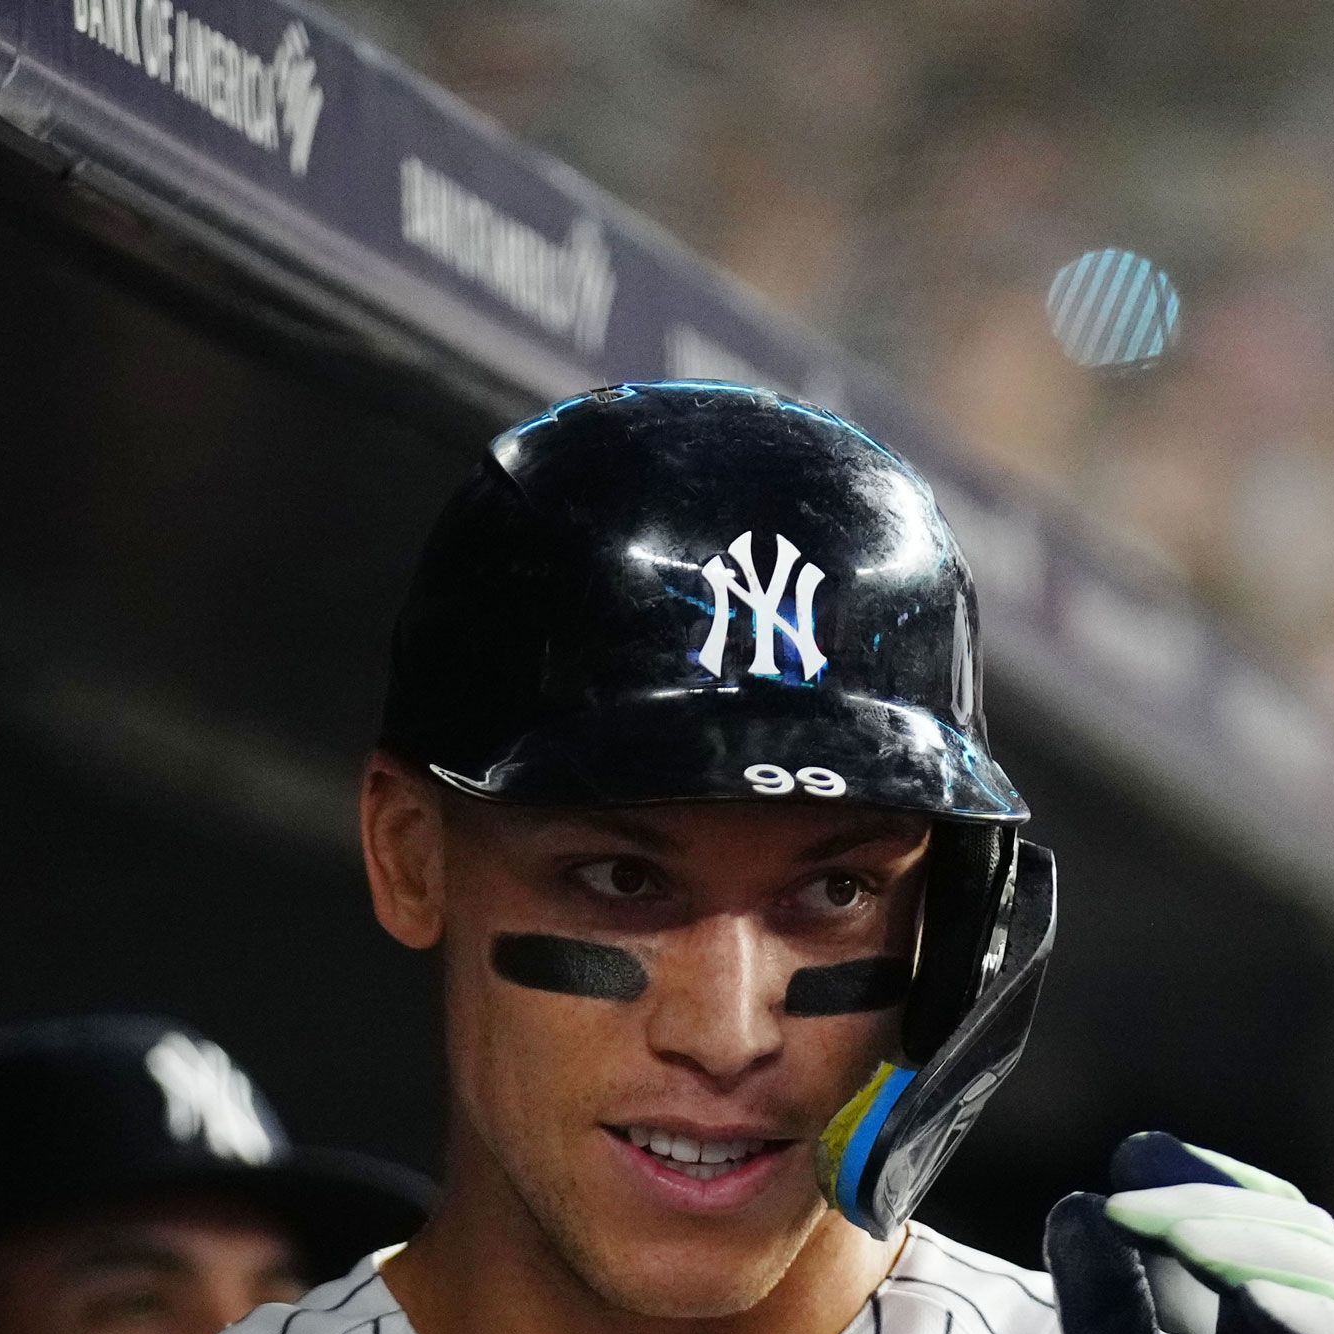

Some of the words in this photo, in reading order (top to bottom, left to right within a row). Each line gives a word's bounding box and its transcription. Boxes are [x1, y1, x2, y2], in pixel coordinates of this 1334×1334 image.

[141, 0, 173, 84] OF
[698, 530, 827, 681] NY
[743, 763, 846, 797] 99
